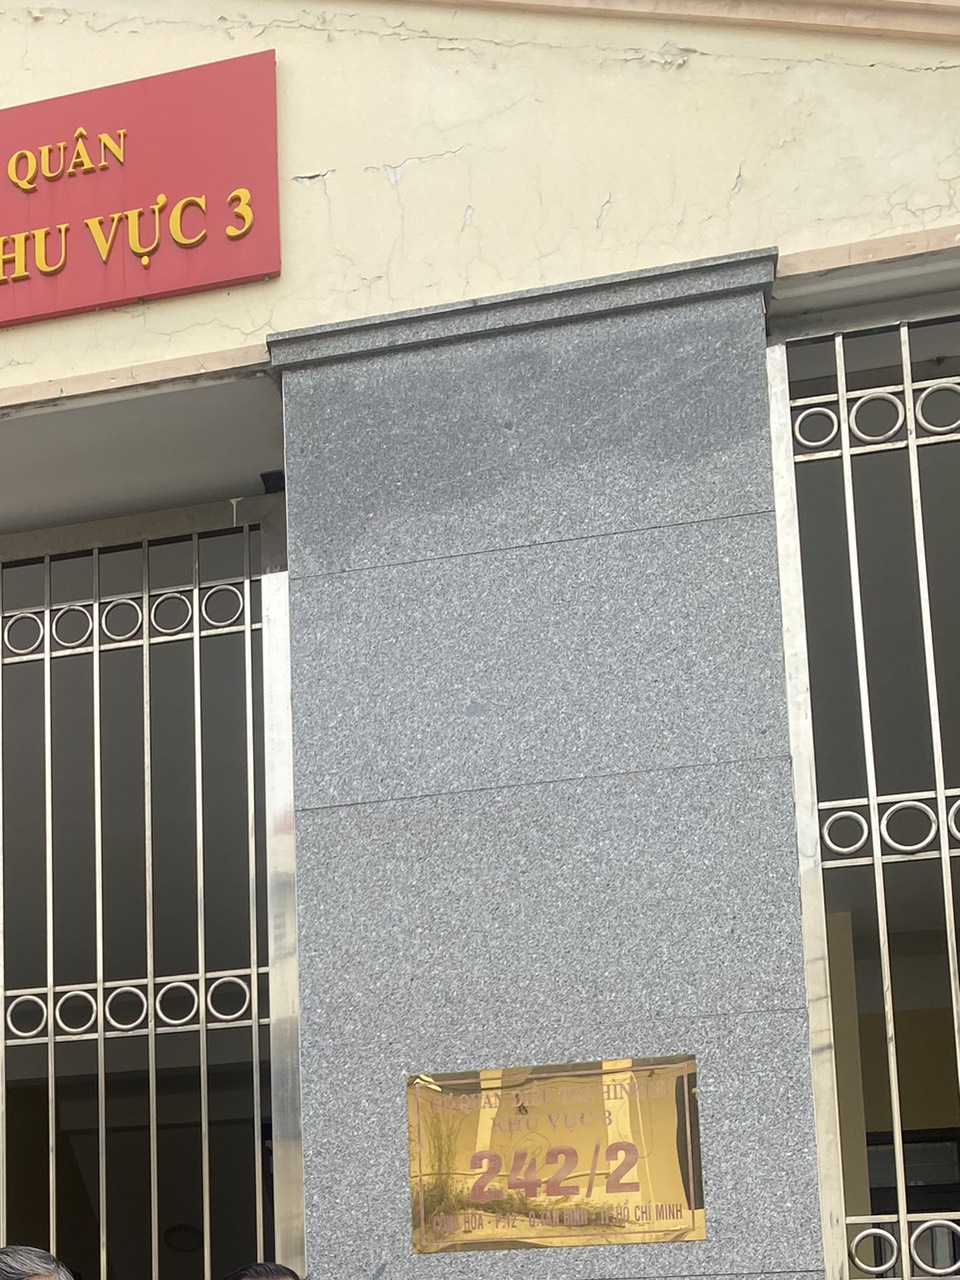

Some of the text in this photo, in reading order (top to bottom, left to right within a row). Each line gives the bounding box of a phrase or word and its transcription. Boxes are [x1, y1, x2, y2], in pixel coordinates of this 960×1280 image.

[7, 126, 128, 193] QUÂN
[85, 193, 208, 266] VỰC
[225, 187, 255, 240] 3
[470, 1139, 641, 1201] 242/2
[655, 1203, 683, 1221] MINH
